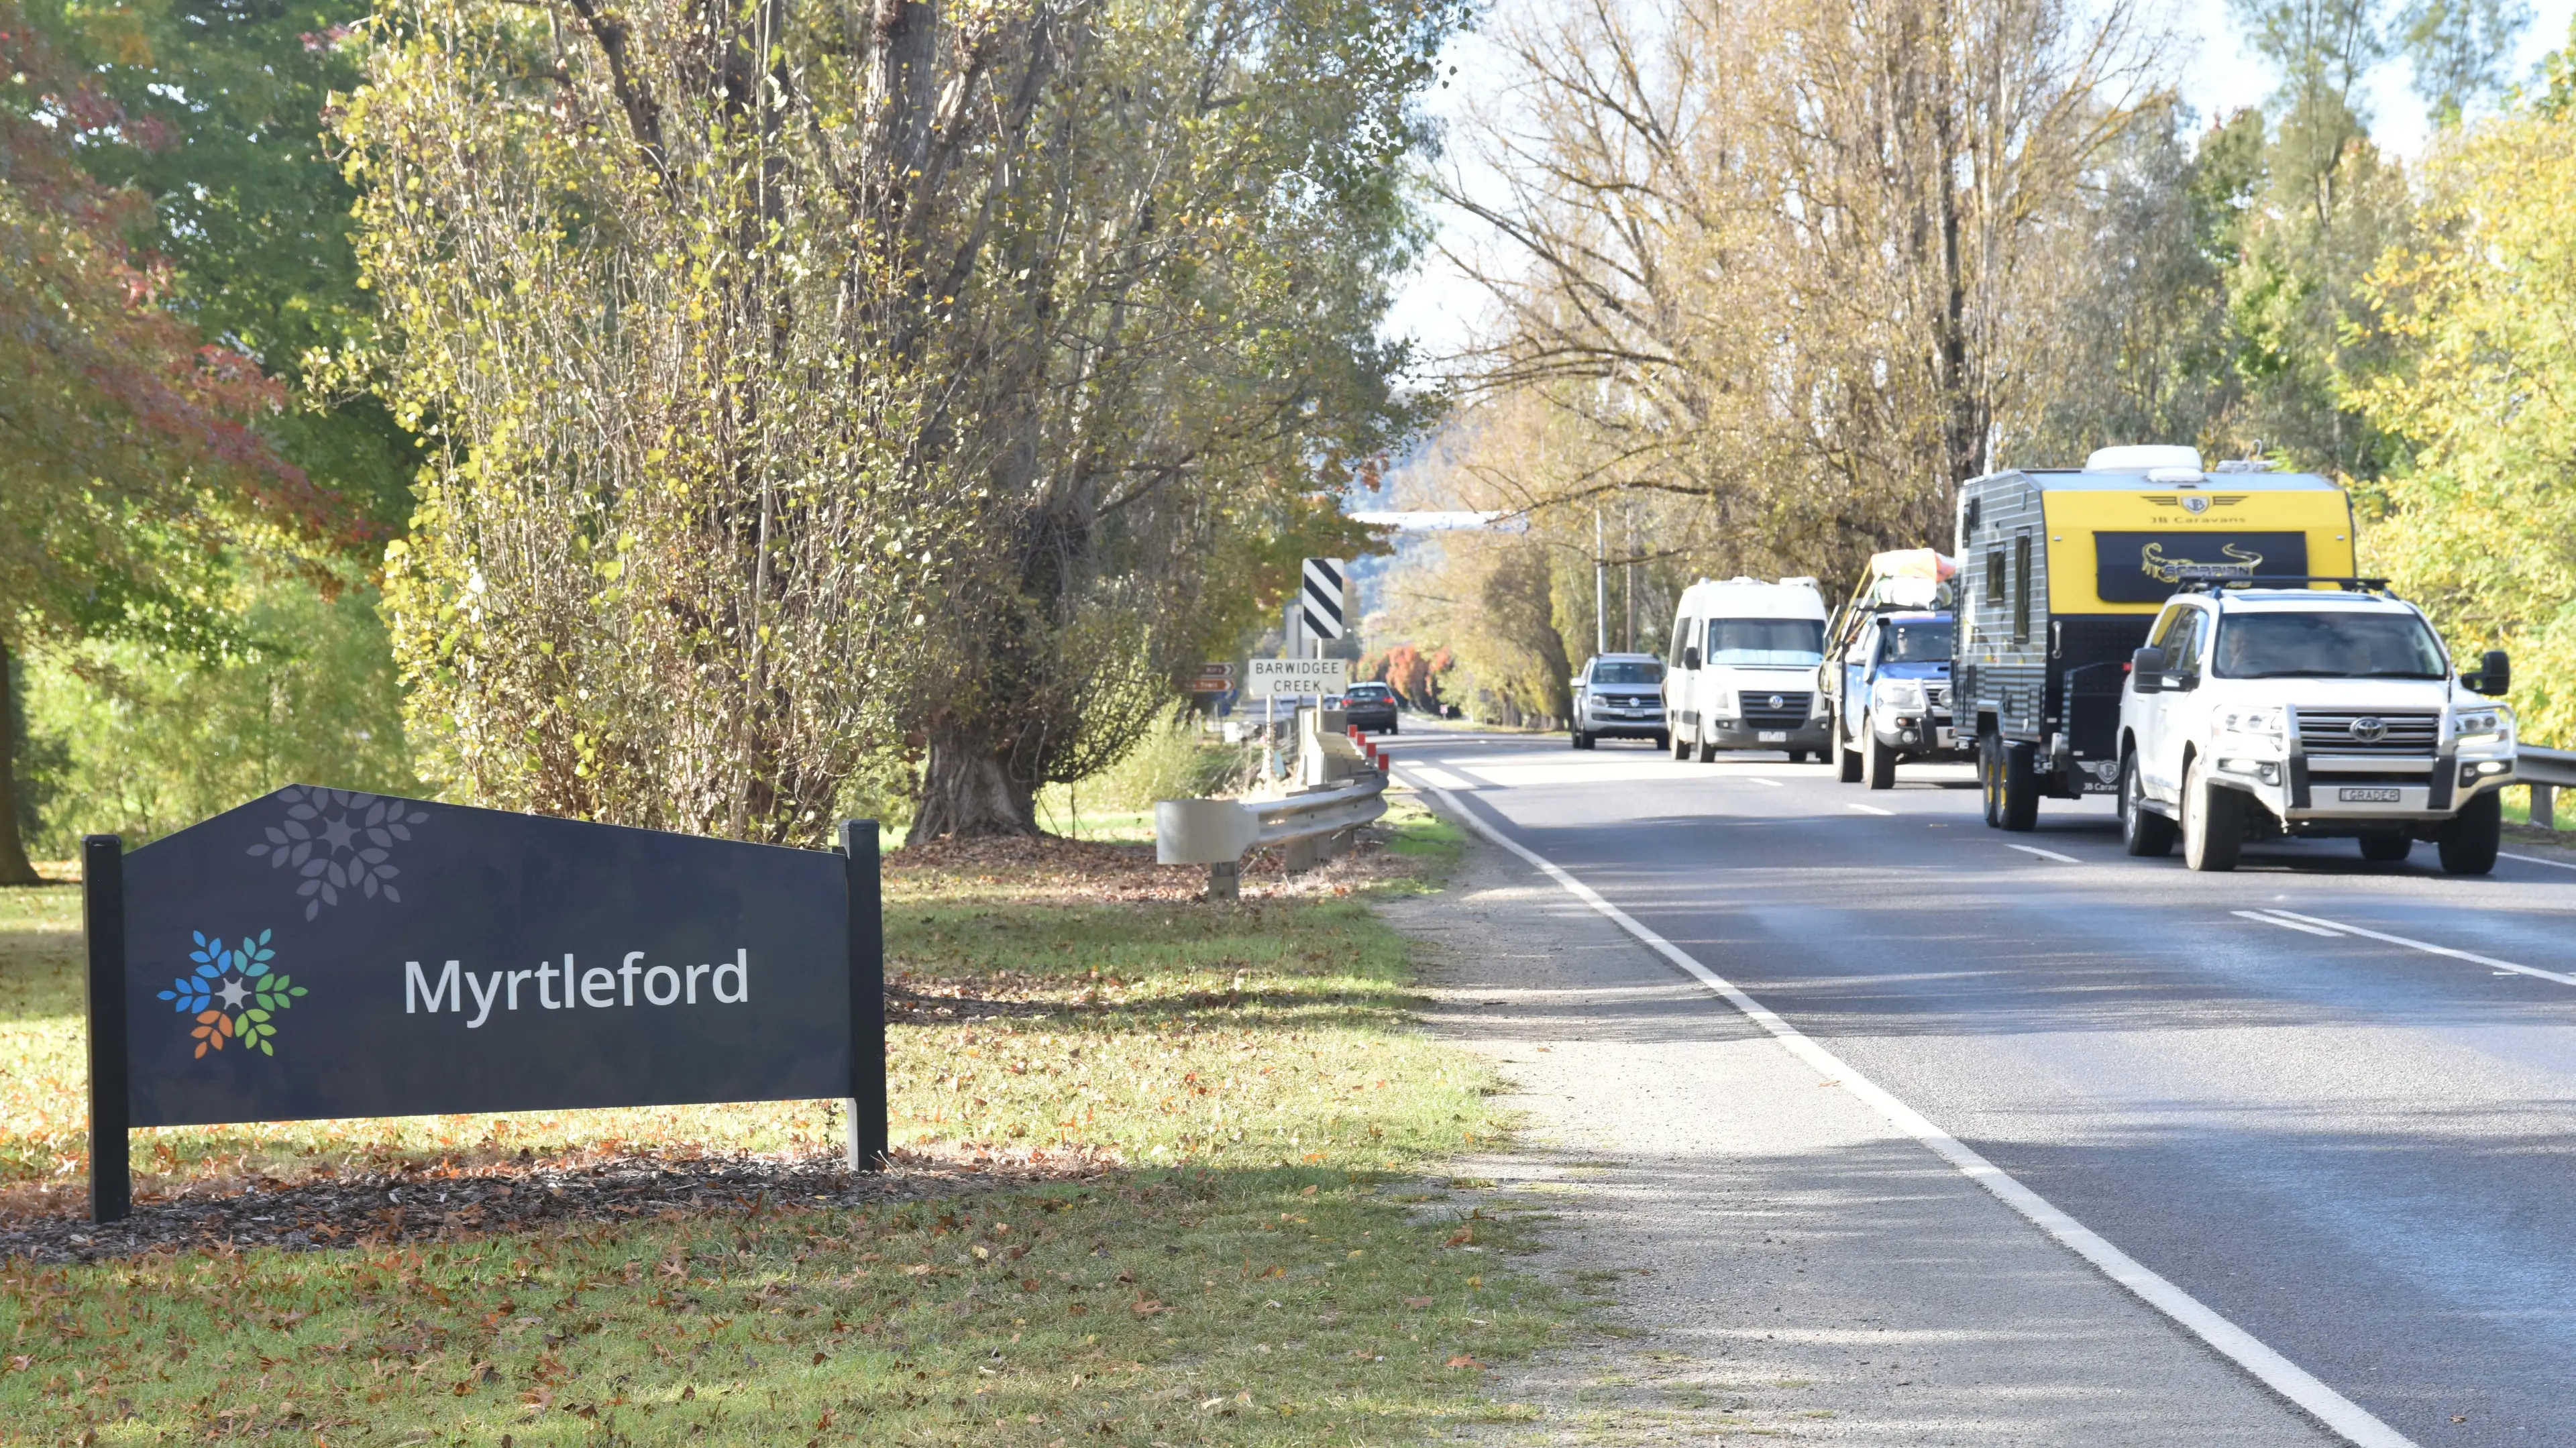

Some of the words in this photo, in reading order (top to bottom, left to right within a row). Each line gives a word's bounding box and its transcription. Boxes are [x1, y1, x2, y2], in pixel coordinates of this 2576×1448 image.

[1256, 663, 1339, 674] BARWIDGEE
[1274, 680, 1321, 692] CREEK
[2094, 783, 2118, 791] Carav
[405, 948, 748, 1028] Myrtleford
